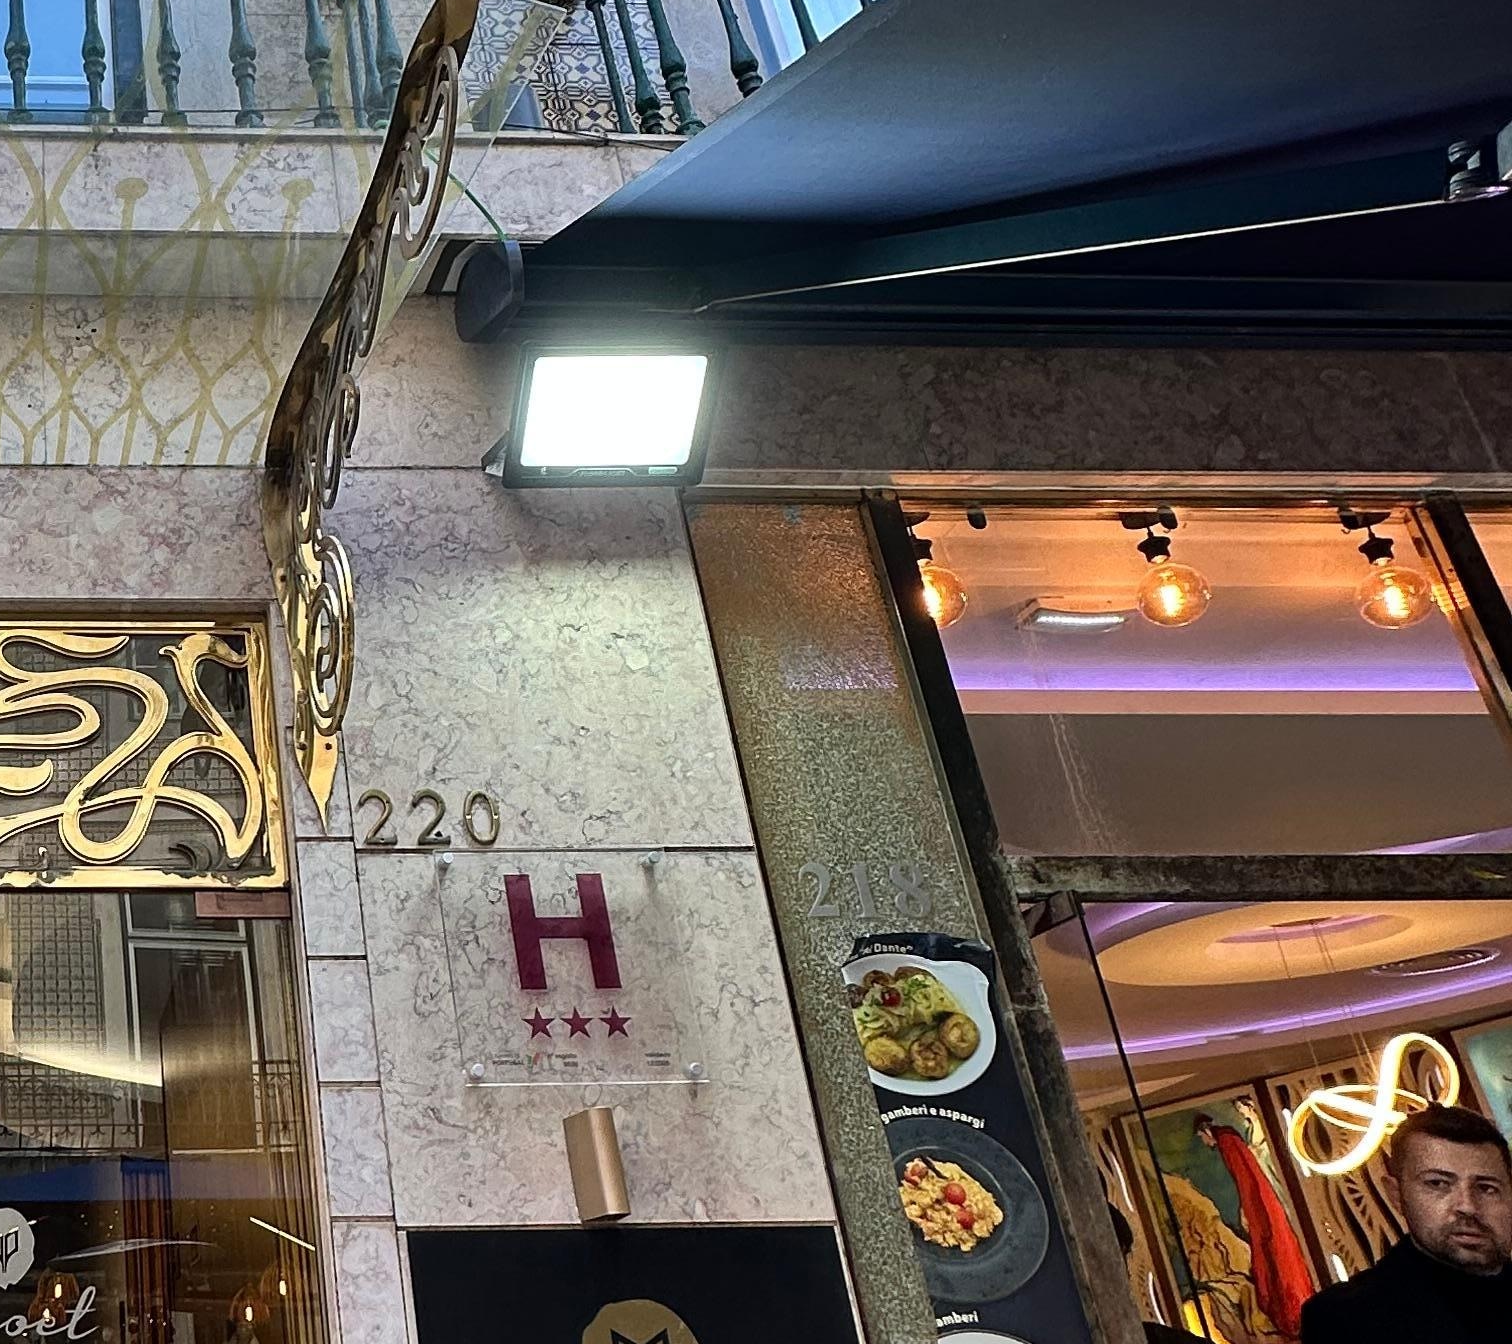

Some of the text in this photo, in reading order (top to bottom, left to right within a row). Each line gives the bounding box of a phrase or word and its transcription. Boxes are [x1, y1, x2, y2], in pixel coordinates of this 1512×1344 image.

[357, 788, 502, 846] 220
[797, 861, 932, 920] 218
[503, 873, 623, 991] H
[880, 1104, 985, 1129] gamberi e aspargi
[935, 1310, 979, 1327] amberi
